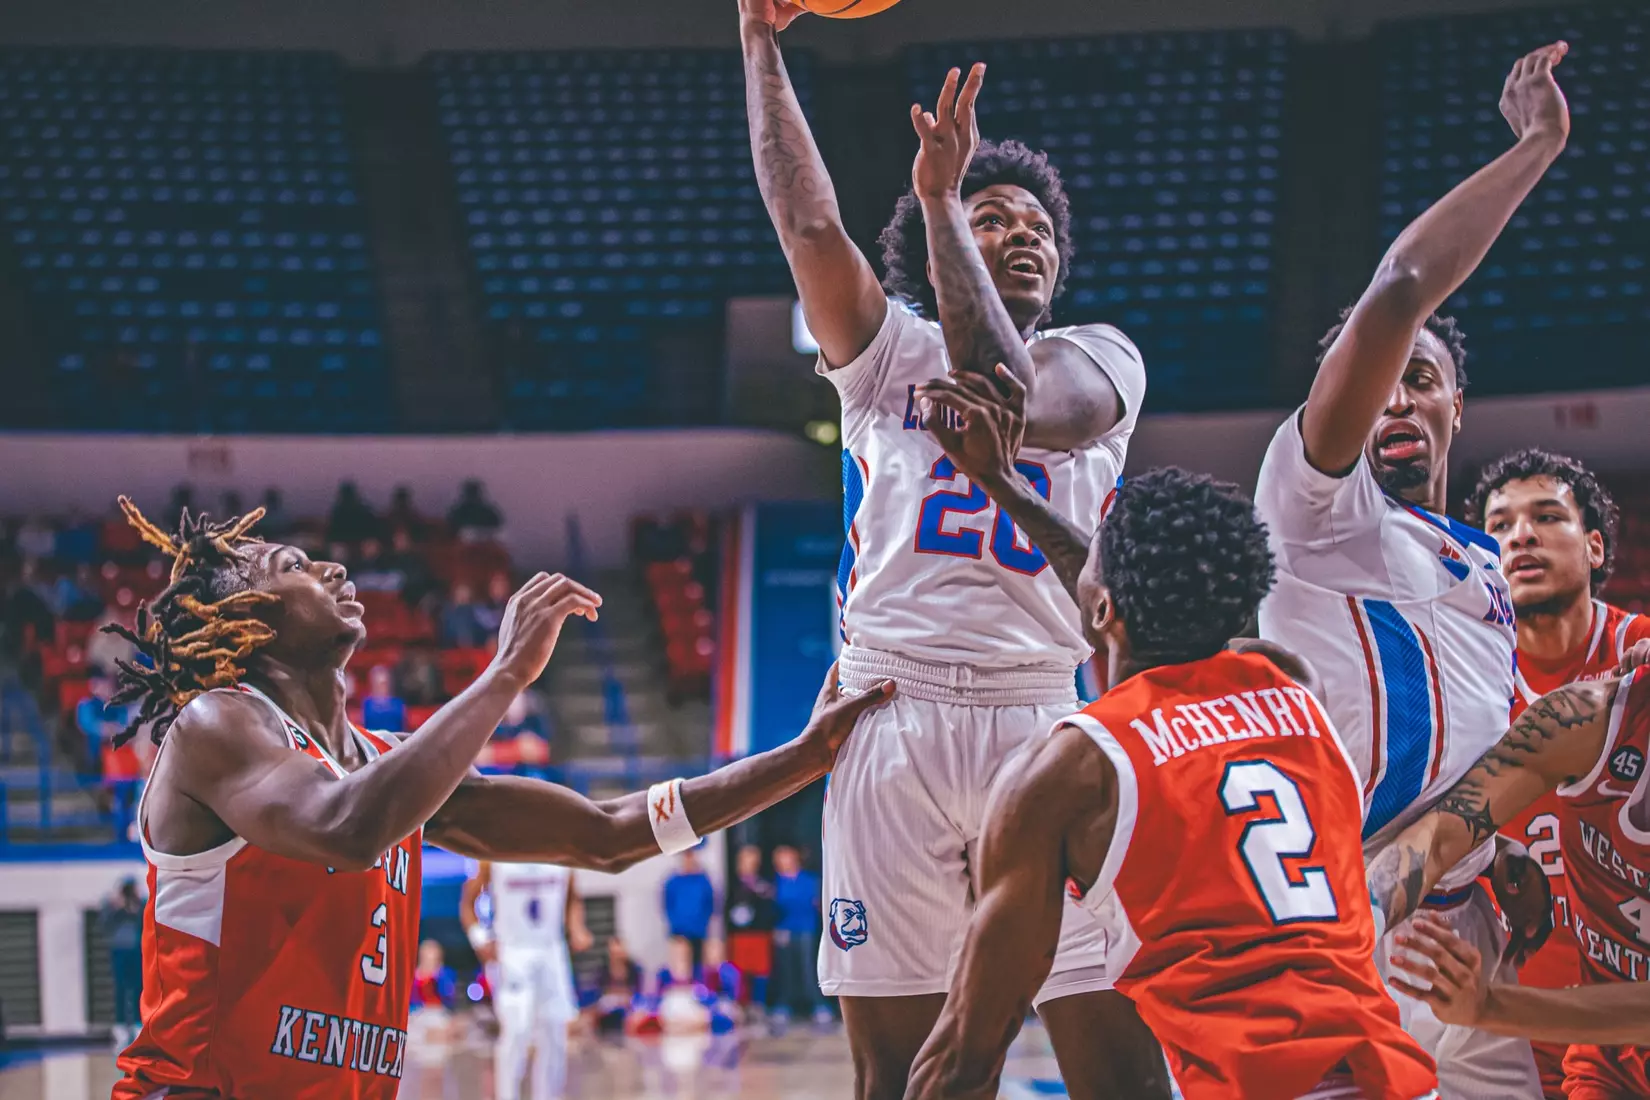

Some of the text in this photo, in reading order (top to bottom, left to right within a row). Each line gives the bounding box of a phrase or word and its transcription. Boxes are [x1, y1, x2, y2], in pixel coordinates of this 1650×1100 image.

[914, 452, 1052, 577] 20
[1130, 686, 1320, 766] McHENRY
[1612, 750, 1642, 777] 45
[1216, 758, 1340, 926] 2
[1579, 817, 1650, 890] WEST
[361, 902, 388, 986] 3
[1573, 911, 1650, 983] KENT
